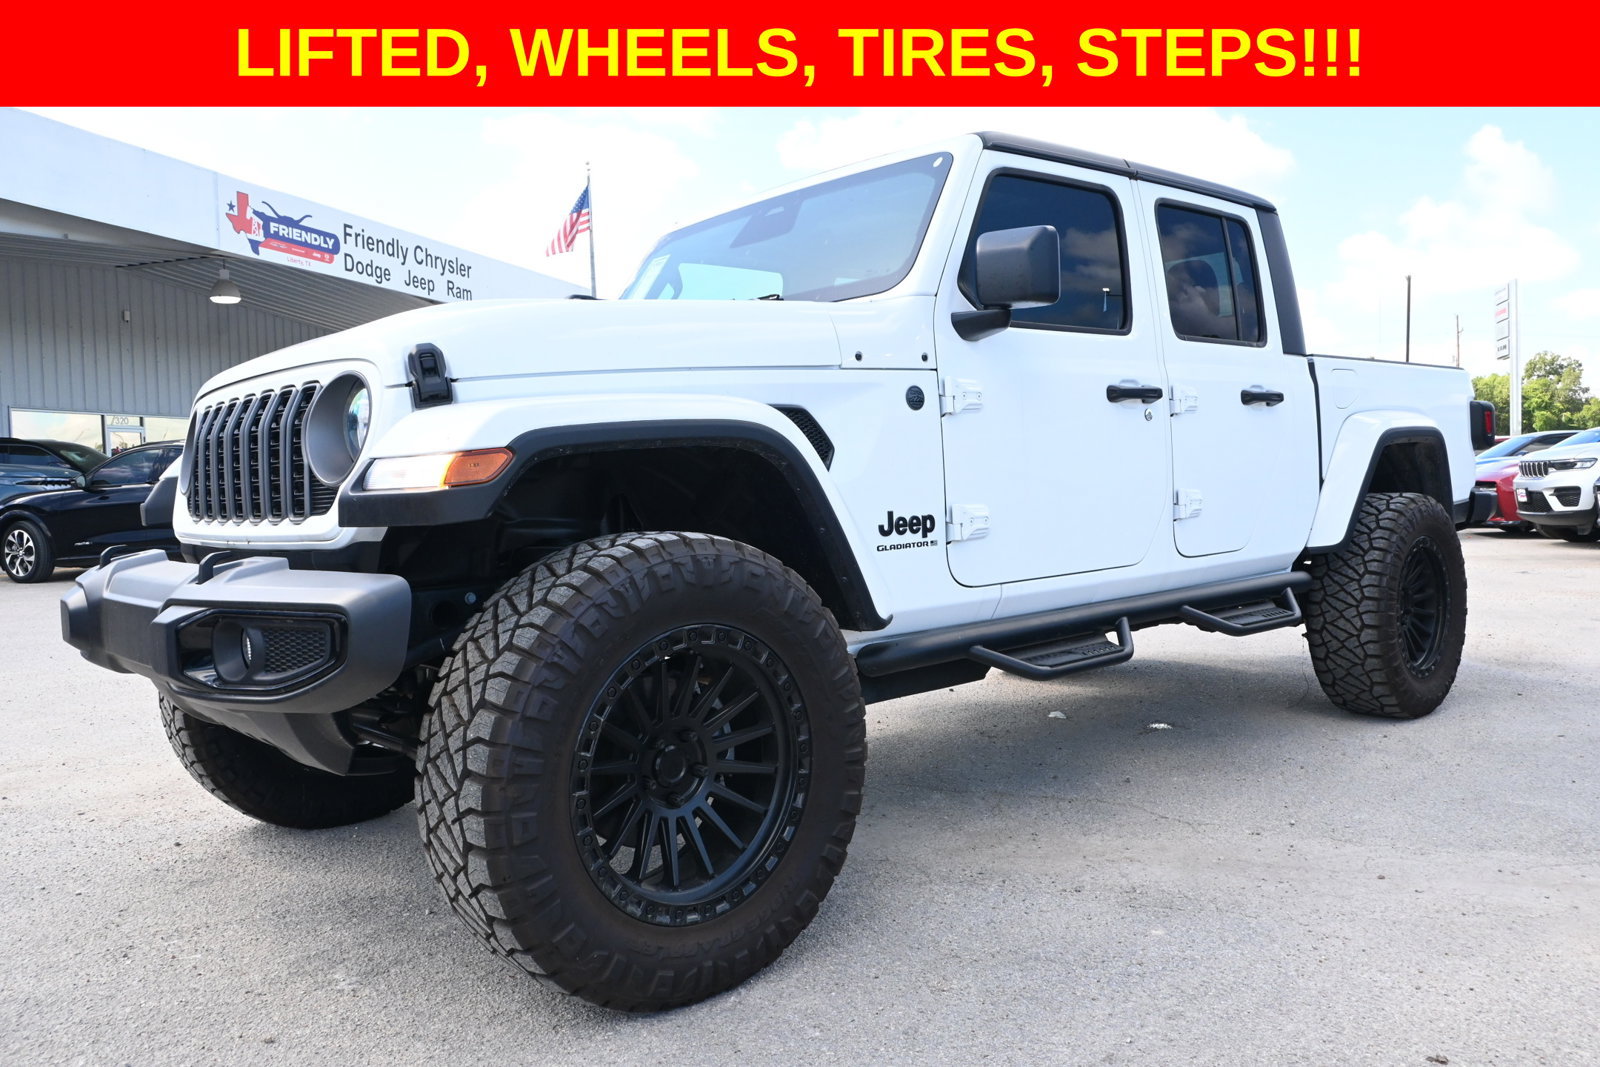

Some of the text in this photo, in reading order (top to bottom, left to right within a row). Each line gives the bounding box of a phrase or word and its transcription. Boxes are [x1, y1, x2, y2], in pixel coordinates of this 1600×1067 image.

[269, 221, 335, 250] FRIENDLY
[343, 223, 472, 278] Friendly Chrysler
[344, 252, 473, 301] Dodge Jeep Ram
[878, 510, 936, 539] Jeep
[876, 541, 929, 552] GLADIATOR
